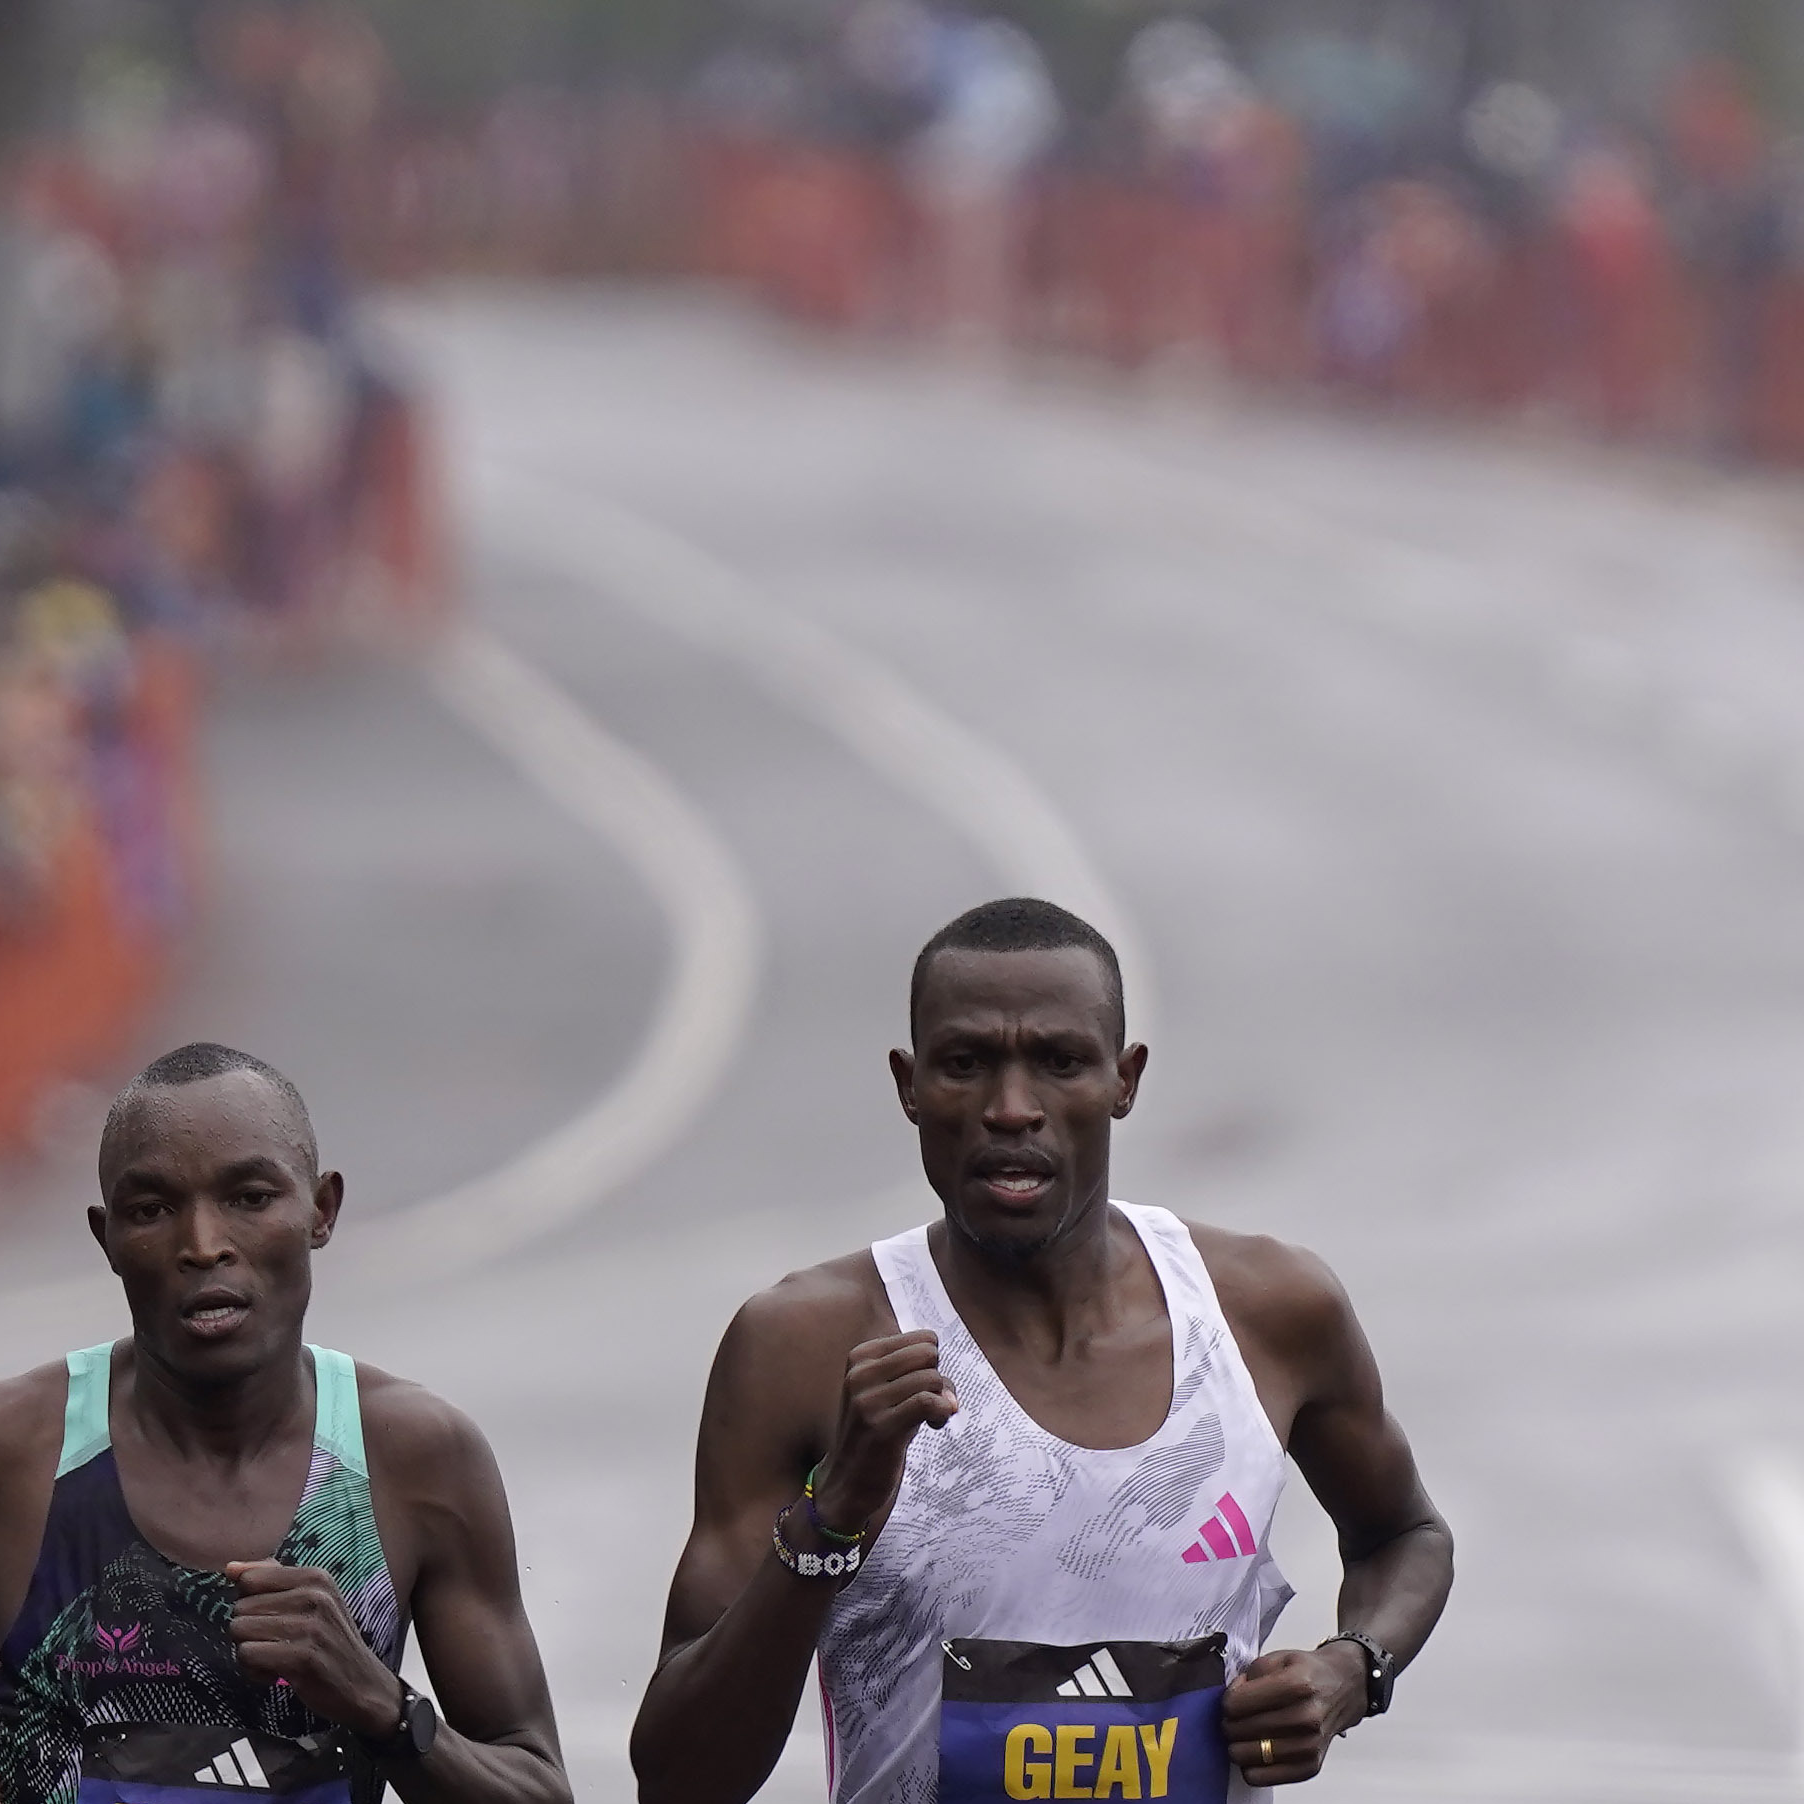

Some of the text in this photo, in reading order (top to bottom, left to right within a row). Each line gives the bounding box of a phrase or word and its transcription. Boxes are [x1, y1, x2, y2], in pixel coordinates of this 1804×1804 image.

[797, 1544, 861, 1576] BOS
[121, 1657, 181, 1678] Angels
[1004, 1717, 1179, 1800] GEAY
